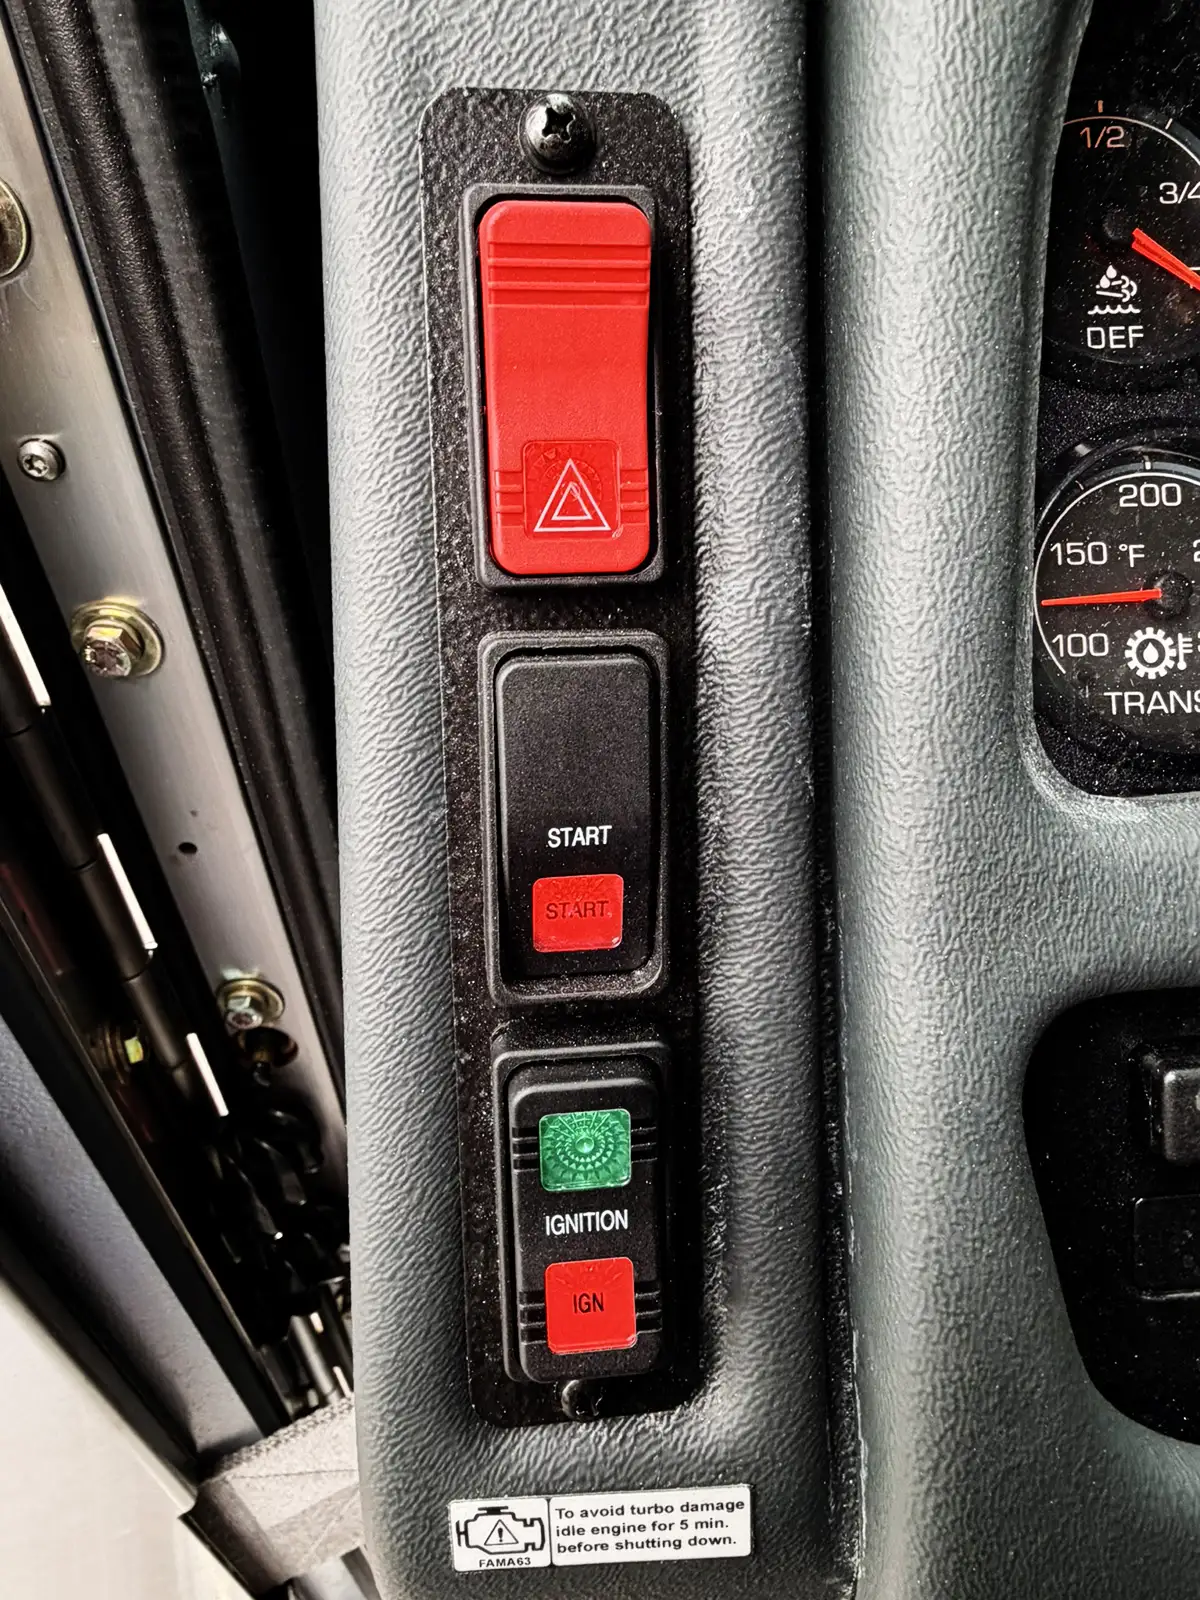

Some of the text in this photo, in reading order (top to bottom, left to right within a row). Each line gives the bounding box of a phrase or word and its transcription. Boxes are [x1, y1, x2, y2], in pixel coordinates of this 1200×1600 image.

[1079, 125, 1125, 149] 1/2
[1086, 325, 1144, 350] DEF
[1118, 482, 1182, 508] 200
[1050, 541, 1108, 566] 150
[1051, 632, 1109, 658] 100
[547, 824, 613, 848] START
[545, 900, 609, 920] START
[545, 1209, 629, 1236] IGNITION
[572, 1292, 605, 1314] IGN
[554, 1500, 745, 1520] To avoid turbo damage
[556, 1517, 729, 1537] idle engine for 5 min.
[557, 1535, 737, 1554] before shutting down.
[478, 1556, 532, 1569] FAMA63
